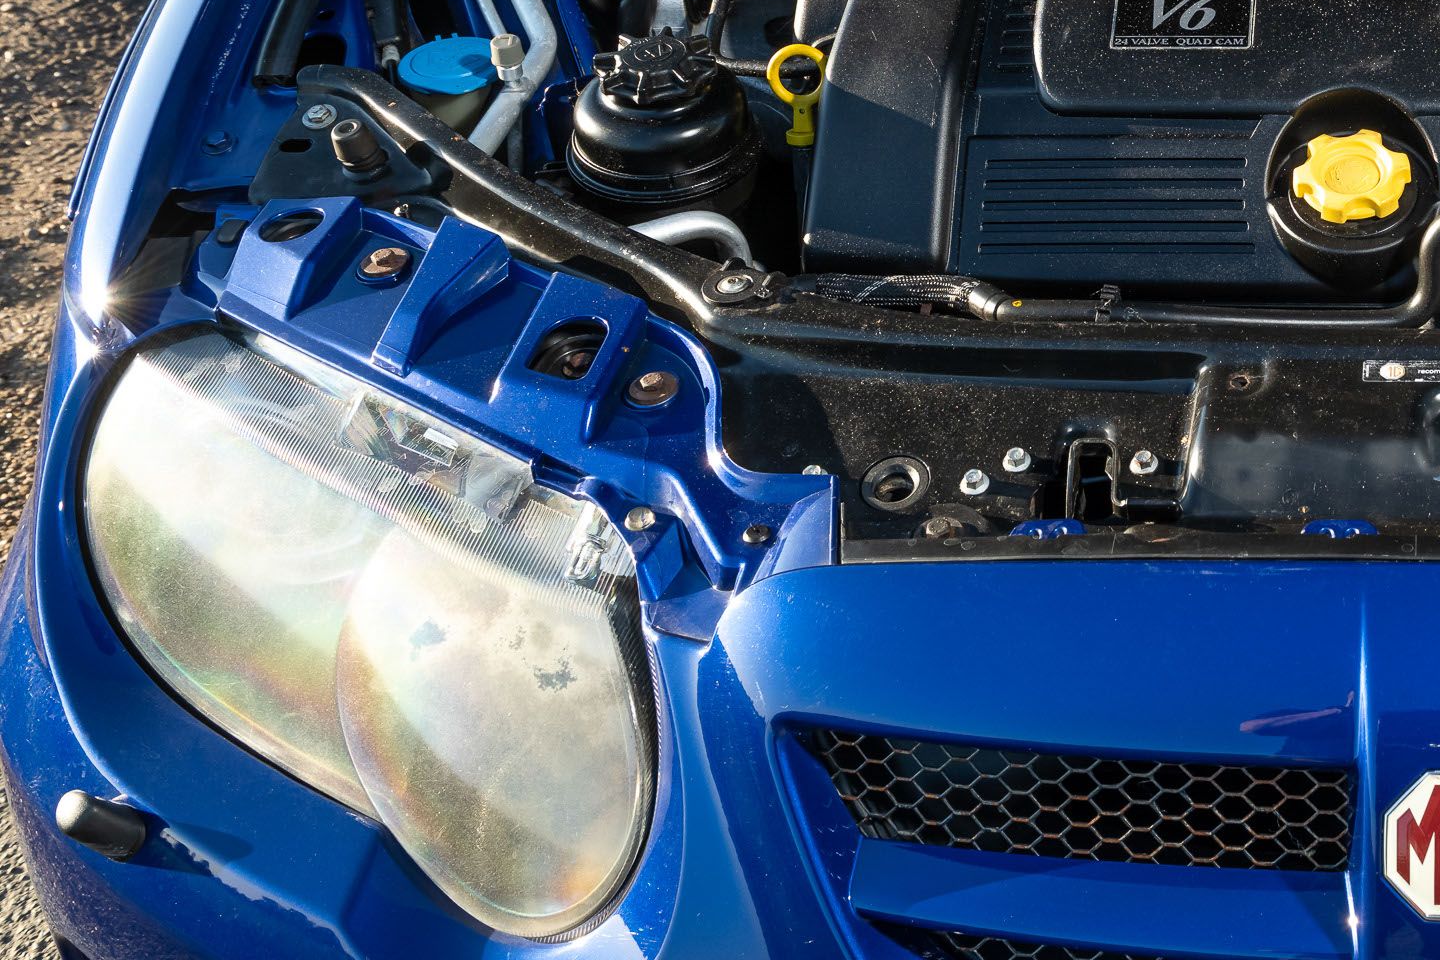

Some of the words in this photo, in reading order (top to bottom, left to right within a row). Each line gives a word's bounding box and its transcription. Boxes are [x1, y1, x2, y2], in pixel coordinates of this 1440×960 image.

[1115, 38, 1128, 46] 24
[1132, 37, 1169, 46] VALVE
[1175, 37, 1212, 46] QUAD
[1215, 37, 1244, 46] CAM
